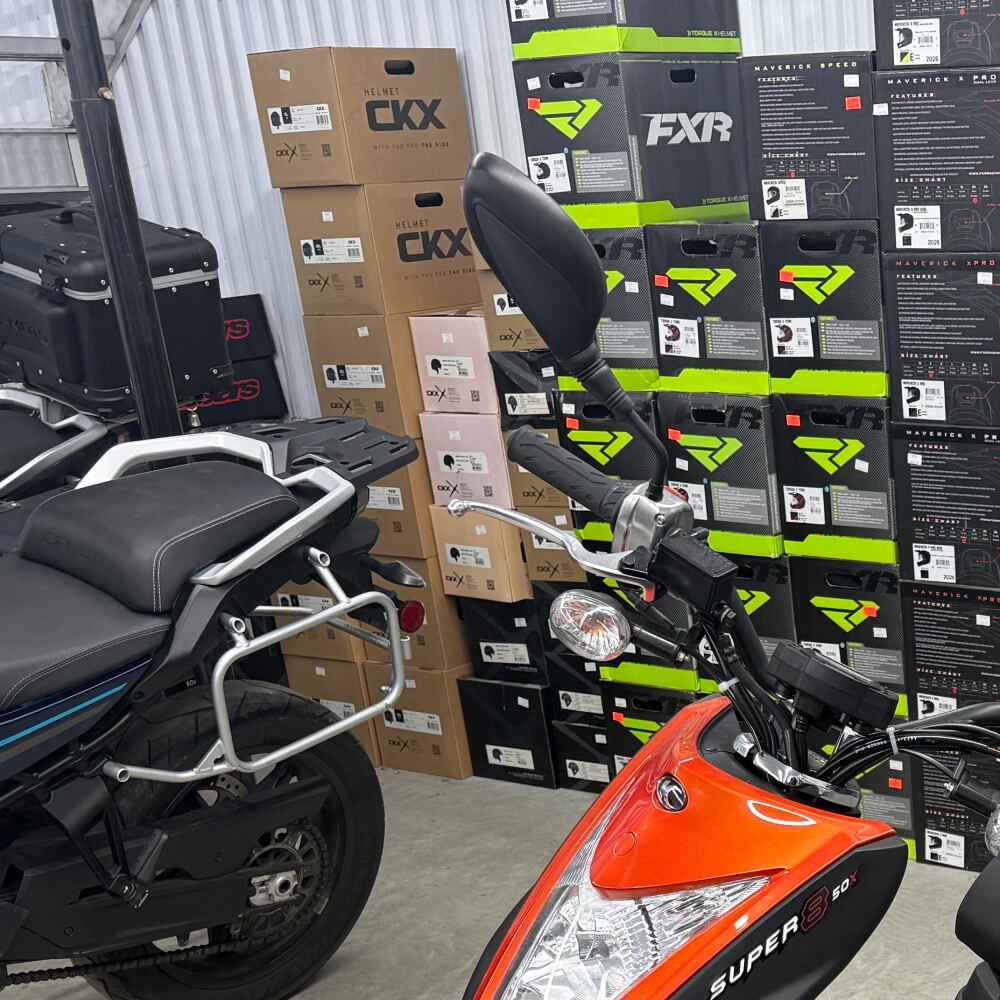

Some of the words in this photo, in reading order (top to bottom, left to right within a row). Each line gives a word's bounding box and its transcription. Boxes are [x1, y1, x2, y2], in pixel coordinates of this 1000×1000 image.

[364, 88, 400, 96] HELMET
[365, 98, 447, 132] CKX
[641, 112, 733, 146] FXR
[397, 228, 473, 262] CKX
